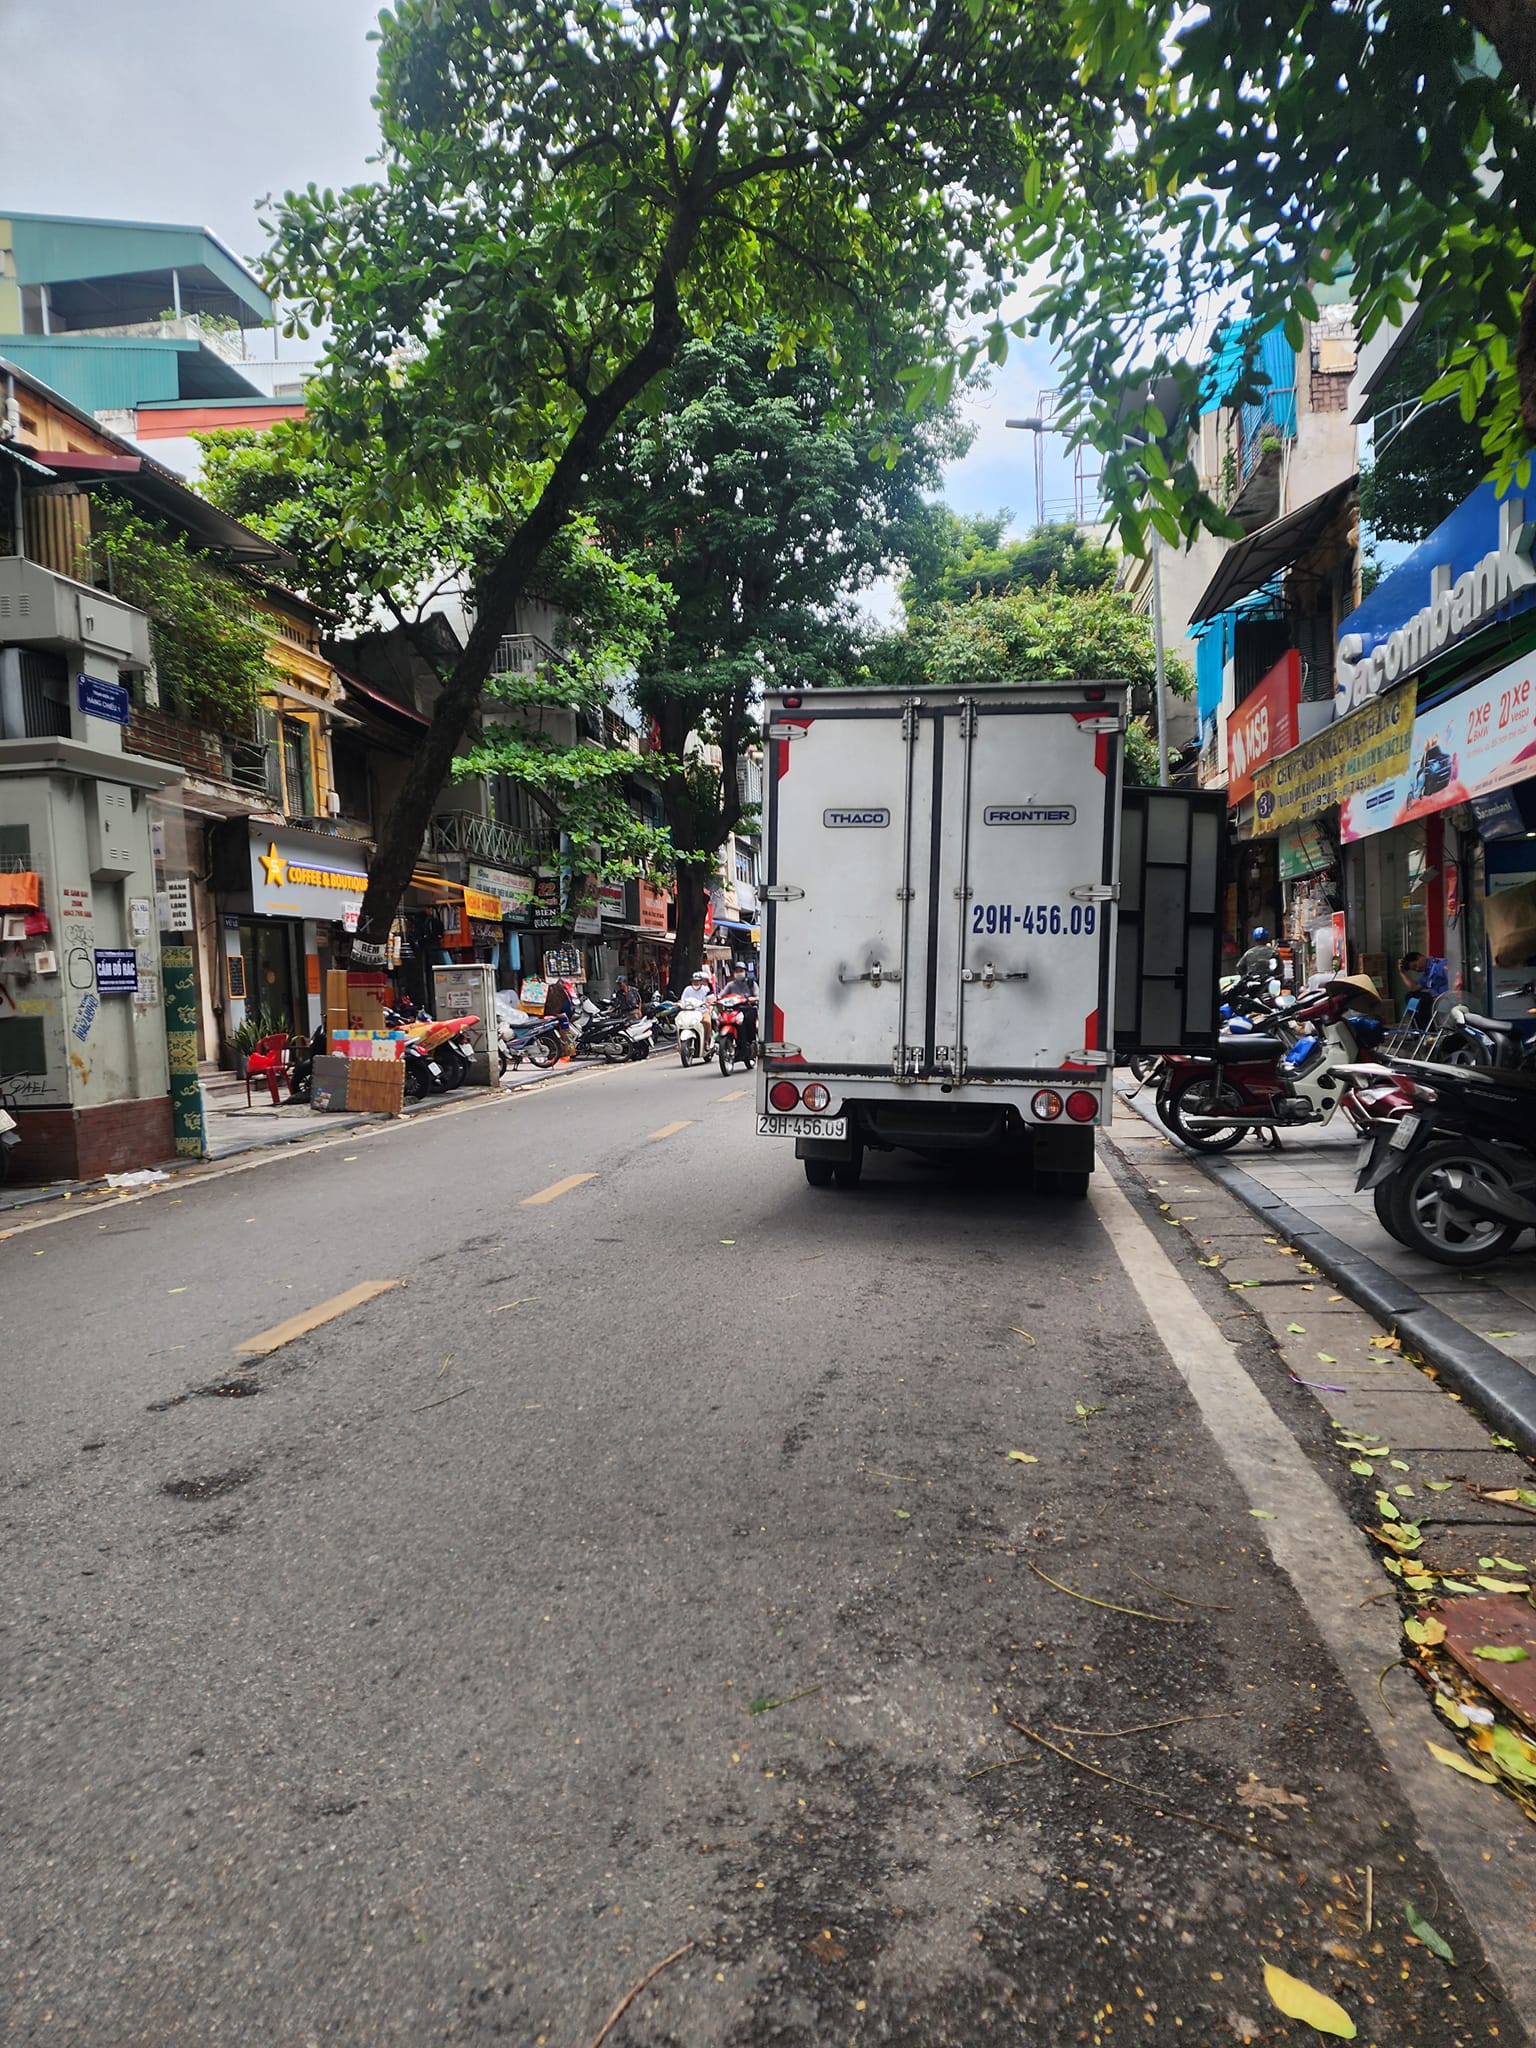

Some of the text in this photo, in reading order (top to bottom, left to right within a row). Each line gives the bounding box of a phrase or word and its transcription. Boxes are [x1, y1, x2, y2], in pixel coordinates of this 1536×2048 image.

[1335, 498, 1536, 717] Sacombank
[1246, 706, 1269, 765] MSB
[830, 813, 884, 823] THACO
[989, 810, 1070, 821] FRONTIER
[287, 866, 321, 886] COFFEE
[972, 904, 1096, 935] 29H-456.09
[97, 958, 112, 976] CẤM
[122, 960, 136, 976] RÁC
[759, 1116, 844, 1137] 29H-456.09
